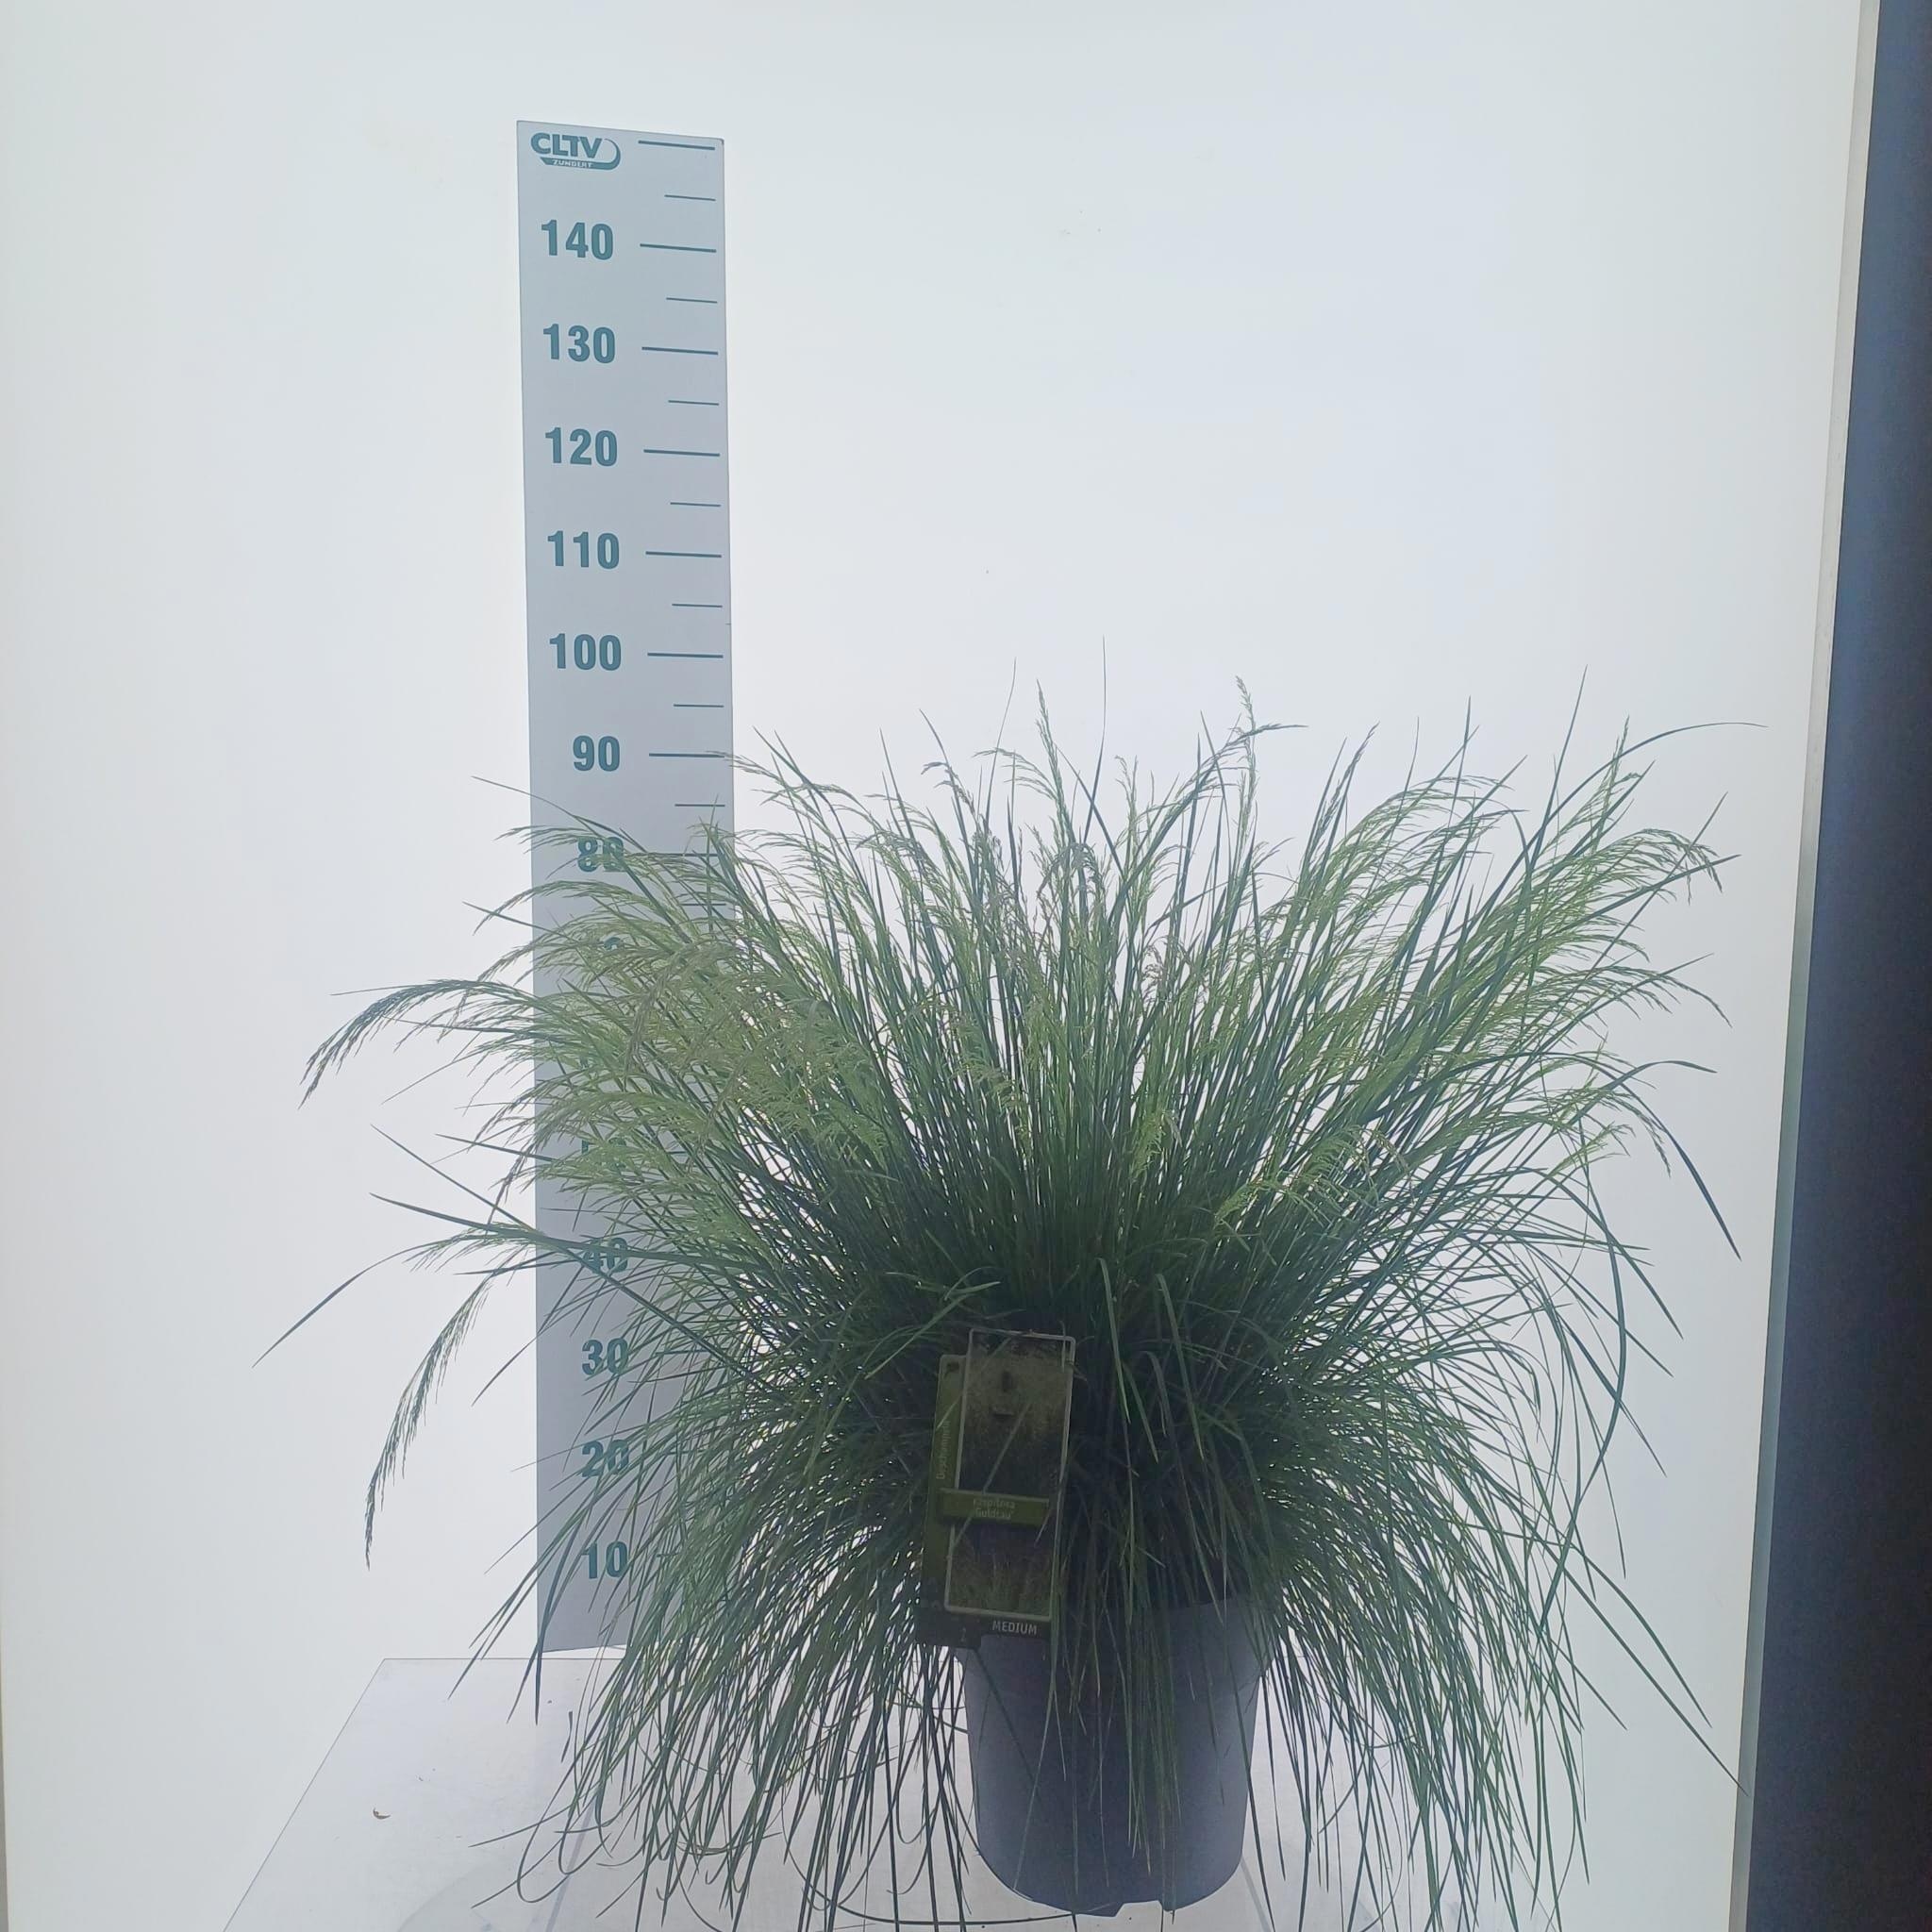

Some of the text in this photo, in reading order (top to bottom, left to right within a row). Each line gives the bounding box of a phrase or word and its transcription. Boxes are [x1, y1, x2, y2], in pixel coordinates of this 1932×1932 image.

[530, 132, 603, 158] CLTV
[541, 219, 614, 260] 140
[542, 323, 616, 363] 130
[544, 426, 618, 467] 120
[547, 530, 620, 570] 110
[549, 633, 622, 672] 100
[573, 735, 621, 772] 90
[581, 1338, 629, 1377] 30
[581, 1439, 630, 1478] 20
[581, 1541, 628, 1580] 10
[991, 1620, 1038, 1636] MEDIUM
